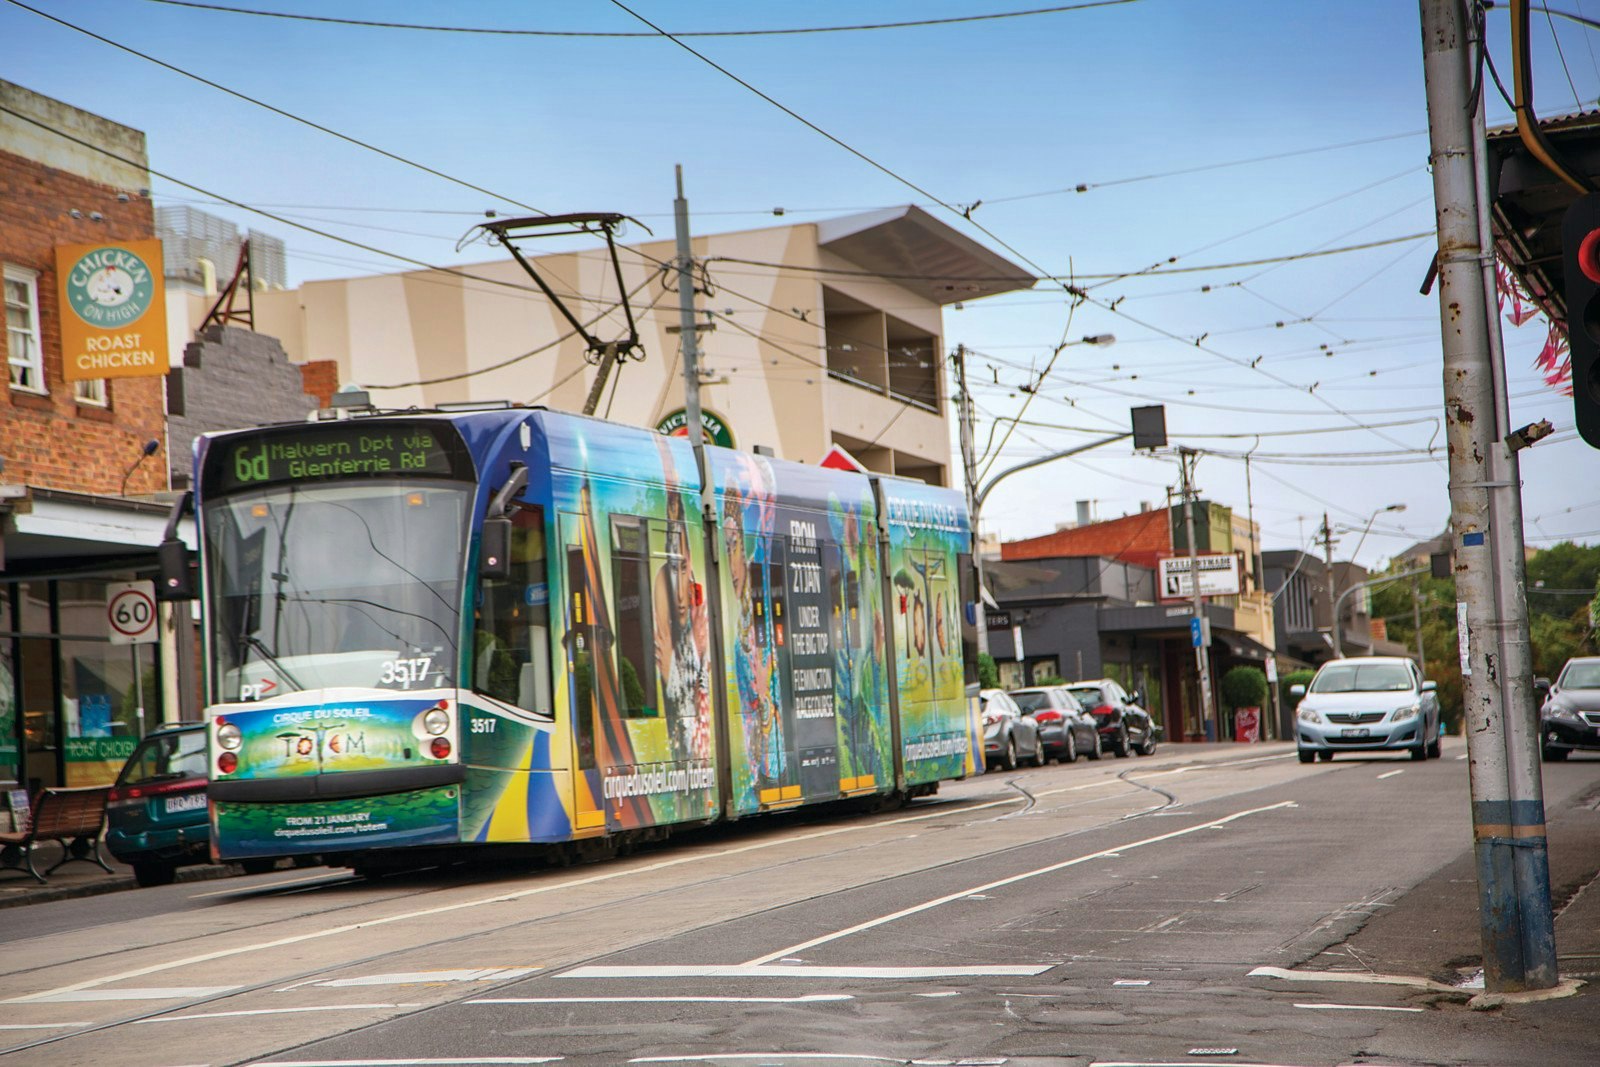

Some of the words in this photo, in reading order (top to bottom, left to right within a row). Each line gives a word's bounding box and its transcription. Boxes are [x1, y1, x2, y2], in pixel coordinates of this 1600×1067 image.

[71, 249, 149, 288] CHICKEN
[83, 304, 104, 321] ON
[106, 302, 141, 322] HIGH
[86, 334, 141, 352] ROAST
[77, 351, 156, 370] CHICKEN
[659, 413, 722, 436] VICTRIA
[271, 441, 350, 460] Malvern
[359, 435, 393, 453] Dpt
[403, 434, 433, 450] via
[235, 445, 269, 482] 6d
[289, 455, 391, 478] Glenferrie
[400, 451, 426, 469] Rd
[789, 520, 817, 554] FROM
[804, 562, 821, 594] JAN
[116, 602, 149, 624] 60
[797, 606, 820, 628] UNDER
[792, 633, 805, 655] THE
[806, 633, 816, 655] BIG
[817, 633, 829, 655] TOP
[380, 658, 432, 684] 3517
[793, 668, 833, 691] FLEMINGTON
[273, 711, 313, 724] CIRQUE
[314, 709, 332, 719] DU
[333, 708, 371, 718] SOLEIL
[470, 718, 497, 733] 3517
[69, 741, 97, 757] ROAST
[603, 760, 715, 807] cirquedusoleil.com/totem
[286, 816, 313, 826] FROM
[314, 816, 326, 825] 21
[327, 812, 370, 824] JANUARY
[274, 823, 388, 839] cirquedusoleil.com/totem
